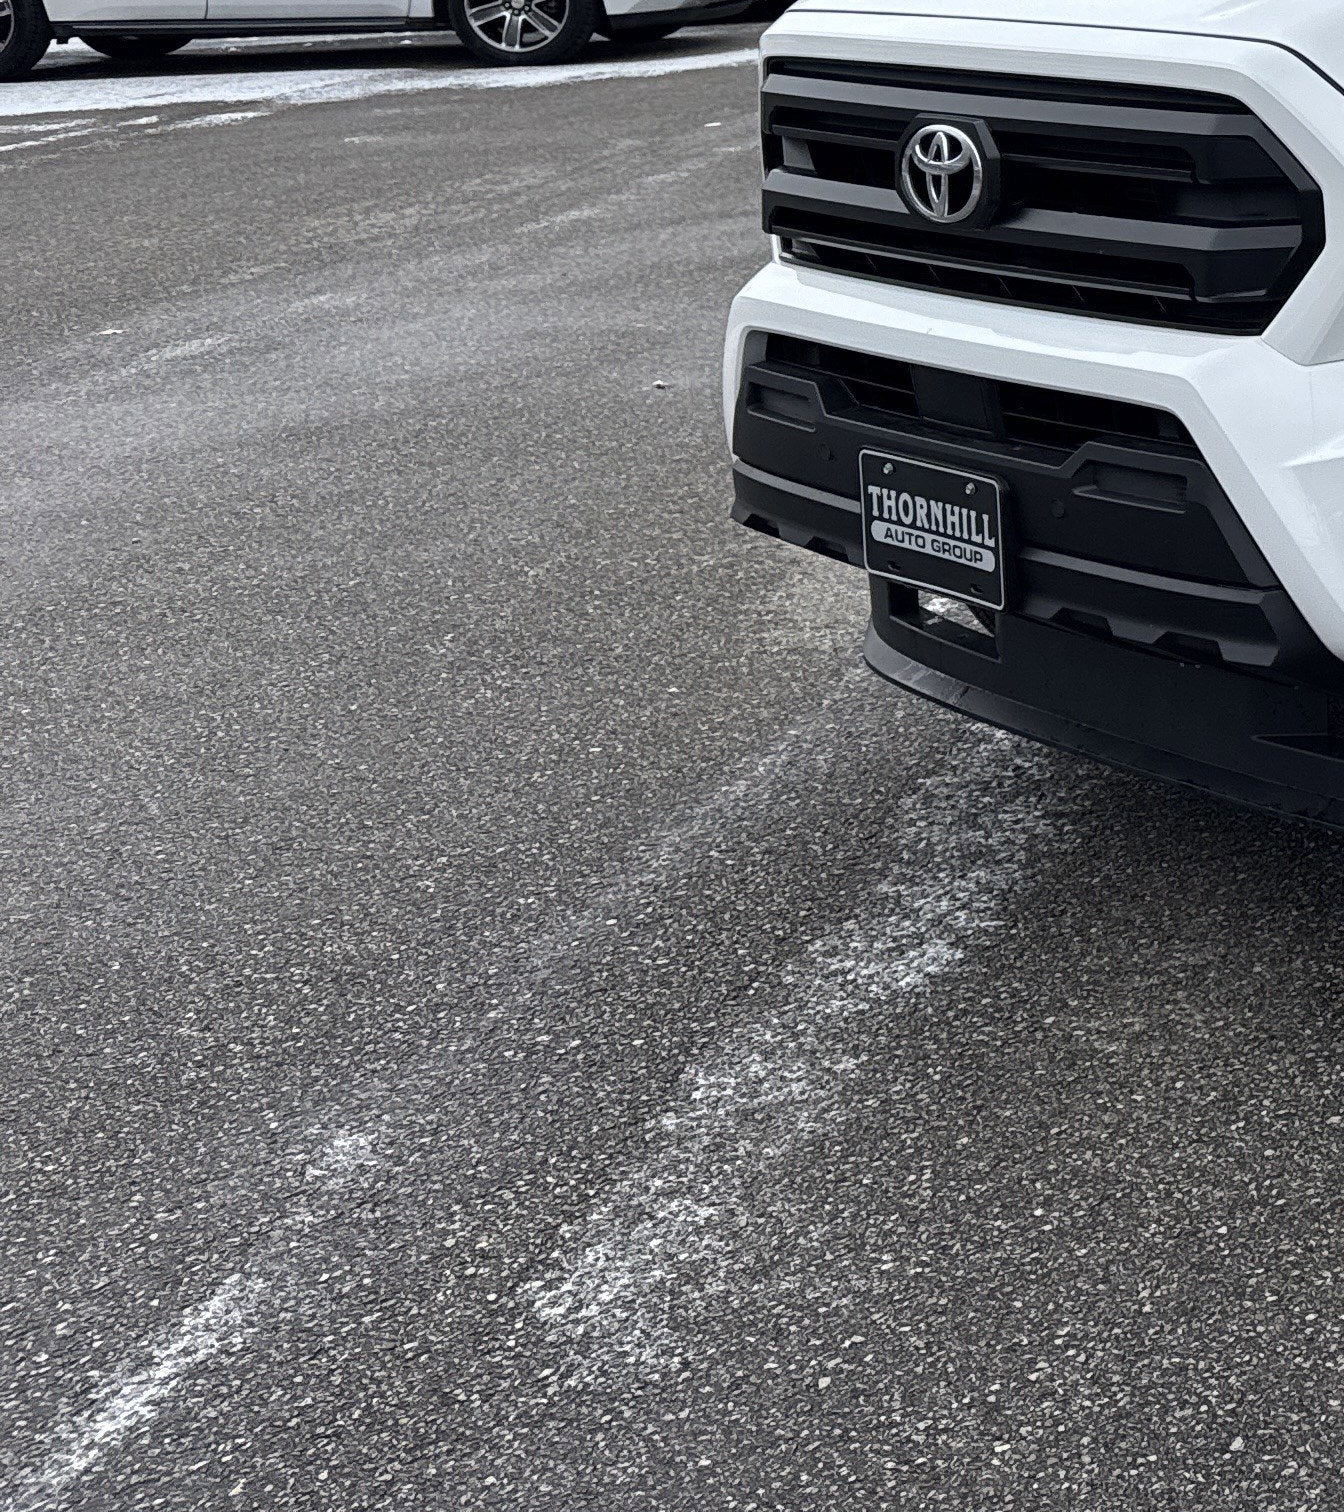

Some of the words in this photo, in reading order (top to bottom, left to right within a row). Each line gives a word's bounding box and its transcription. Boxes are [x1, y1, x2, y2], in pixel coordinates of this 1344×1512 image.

[867, 485, 996, 548] THORNHILL
[884, 526, 926, 549] AUTO
[931, 538, 983, 565] GROUP
